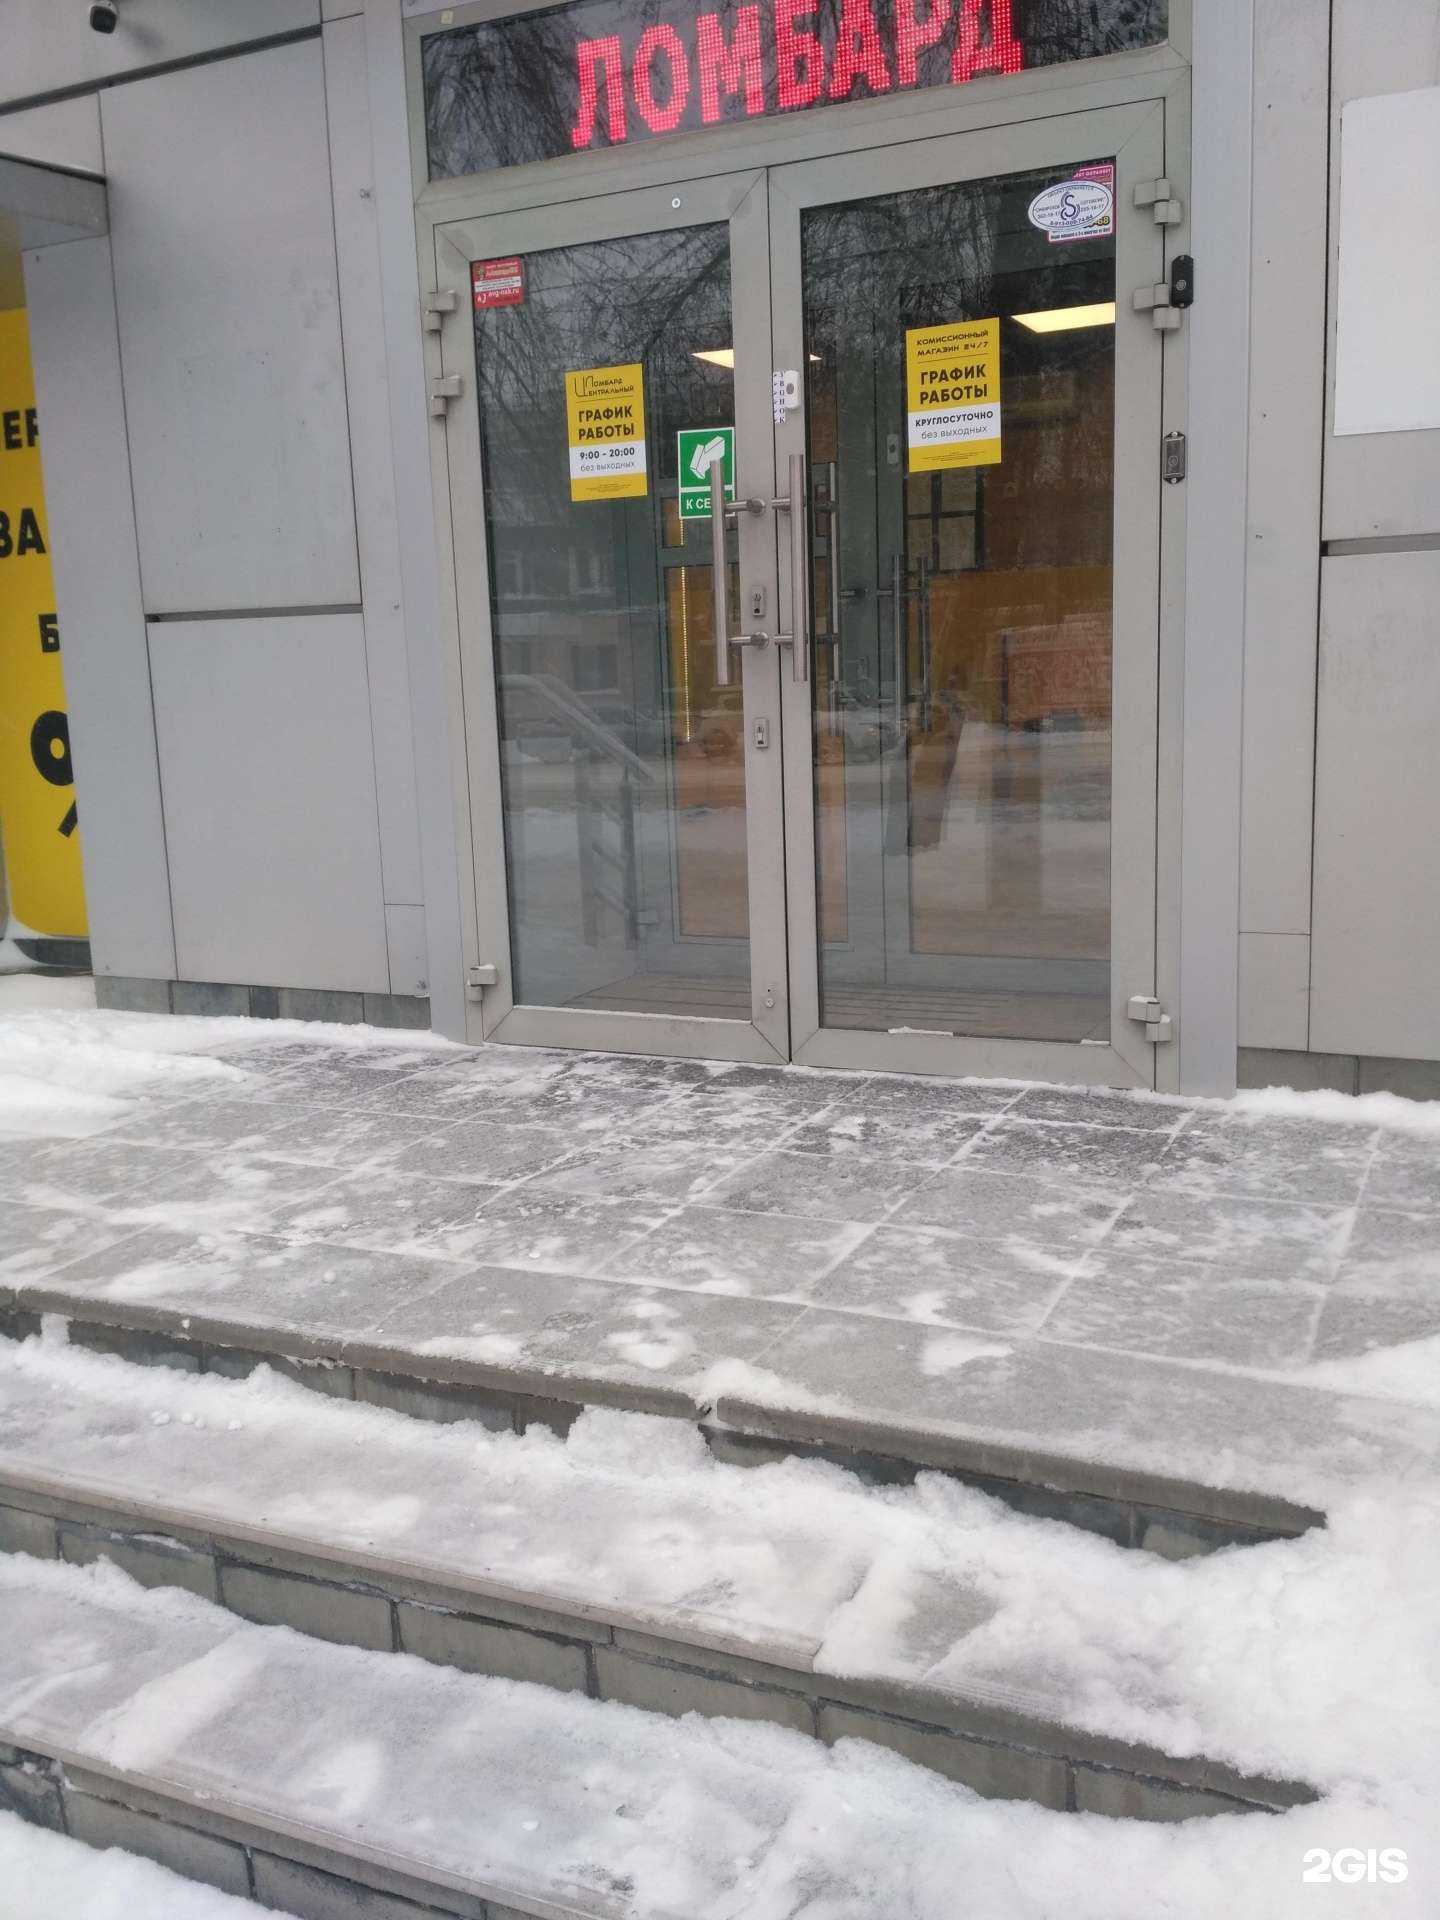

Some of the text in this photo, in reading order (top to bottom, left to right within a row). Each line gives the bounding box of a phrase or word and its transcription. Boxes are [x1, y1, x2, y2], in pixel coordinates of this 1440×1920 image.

[572, 0, 1022, 149] ЛОМБАРД
[916, 330, 989, 346] КОМИССИОННЫЙ
[917, 341, 989, 356] МАГАЗИН 24/7
[920, 364, 987, 385] ГРАФИК
[920, 384, 988, 404] РАБОТЫ
[578, 405, 633, 423] ГРАФИК
[915, 411, 994, 427] КРУГЛОСУТОЧНО
[578, 423, 635, 440] РАБОТЫ
[921, 426, 988, 440] без выходных
[580, 451, 600, 460] 9:00
[609, 447, 635, 458] 20:00
[580, 461, 635, 472] без выходных
[686, 499, 693, 509] К
